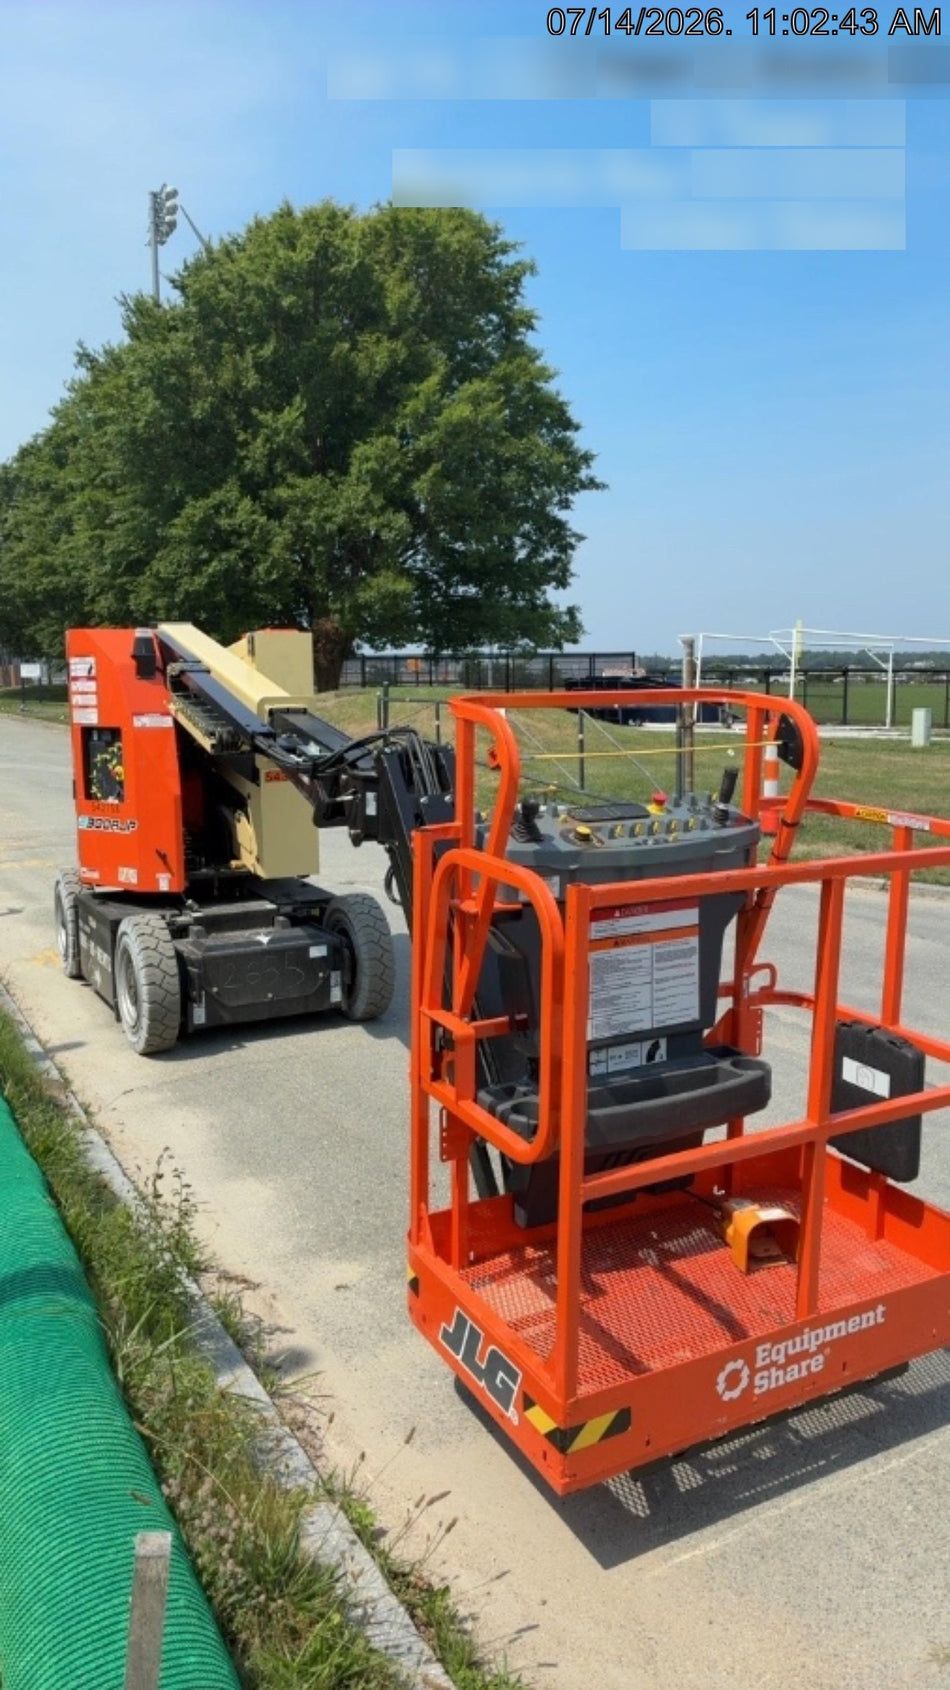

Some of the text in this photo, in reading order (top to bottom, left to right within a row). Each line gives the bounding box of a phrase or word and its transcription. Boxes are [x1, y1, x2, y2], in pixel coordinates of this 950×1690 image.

[438, 1306, 523, 1416] JLG
[755, 1304, 887, 1367] Equipment
[753, 1352, 825, 1394] Share
